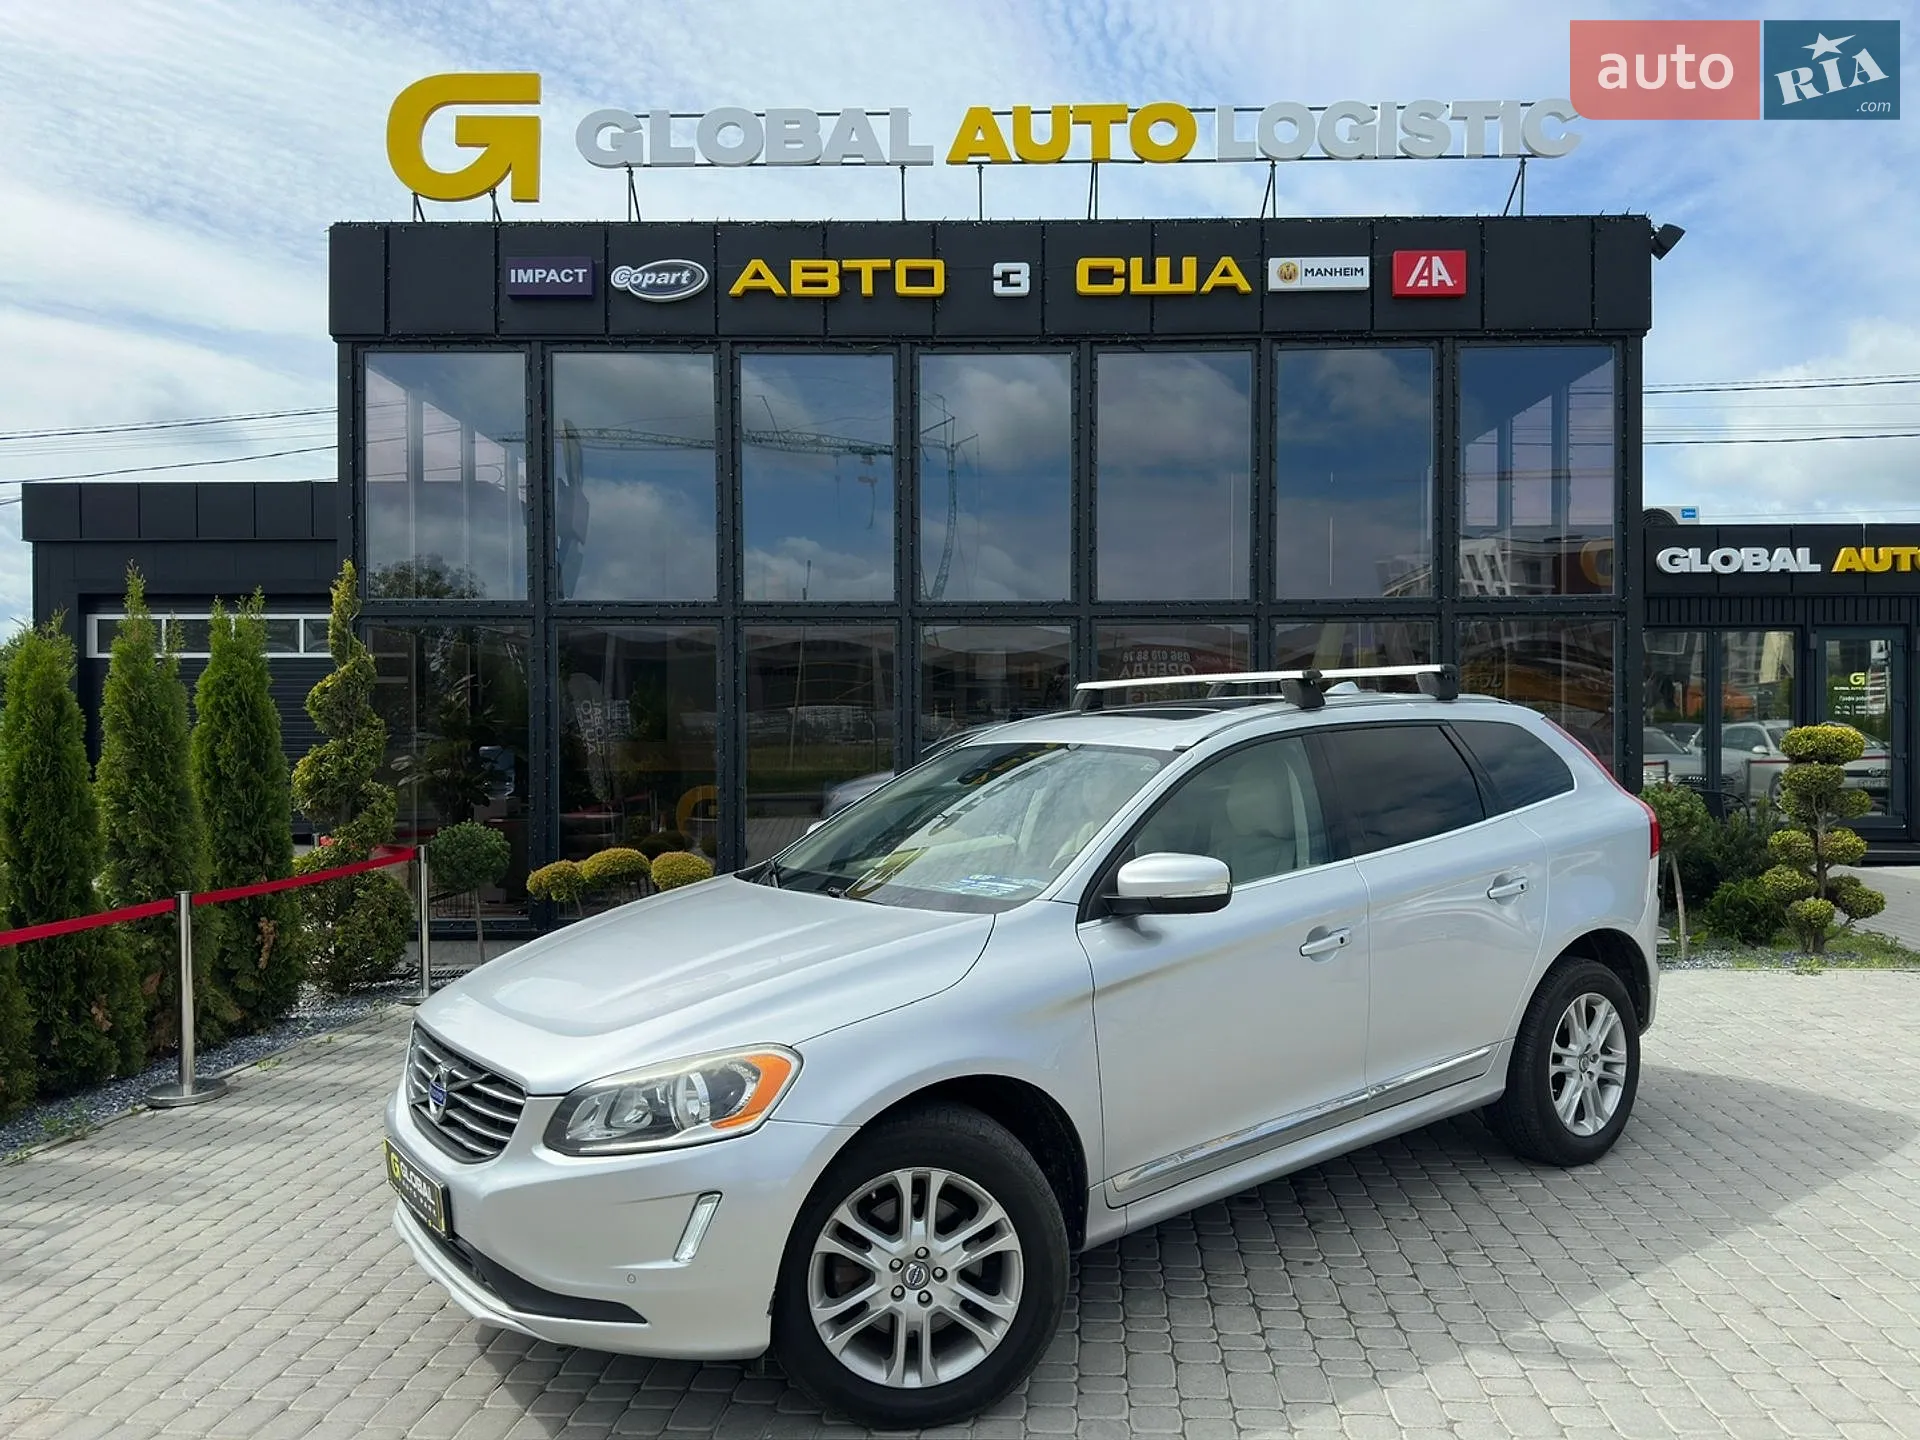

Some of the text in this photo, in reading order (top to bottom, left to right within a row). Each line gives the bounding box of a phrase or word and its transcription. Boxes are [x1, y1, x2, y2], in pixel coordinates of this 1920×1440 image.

[575, 98, 1584, 168] GLOBAL AUTO LOGISTIC
[510, 268, 588, 284] IMPACT
[613, 266, 692, 289] Copart
[728, 257, 947, 298] АВТО
[1076, 256, 1253, 296] США
[1304, 267, 1365, 277] MANHEIM
[1656, 546, 1920, 574] GLOBAL AUT
